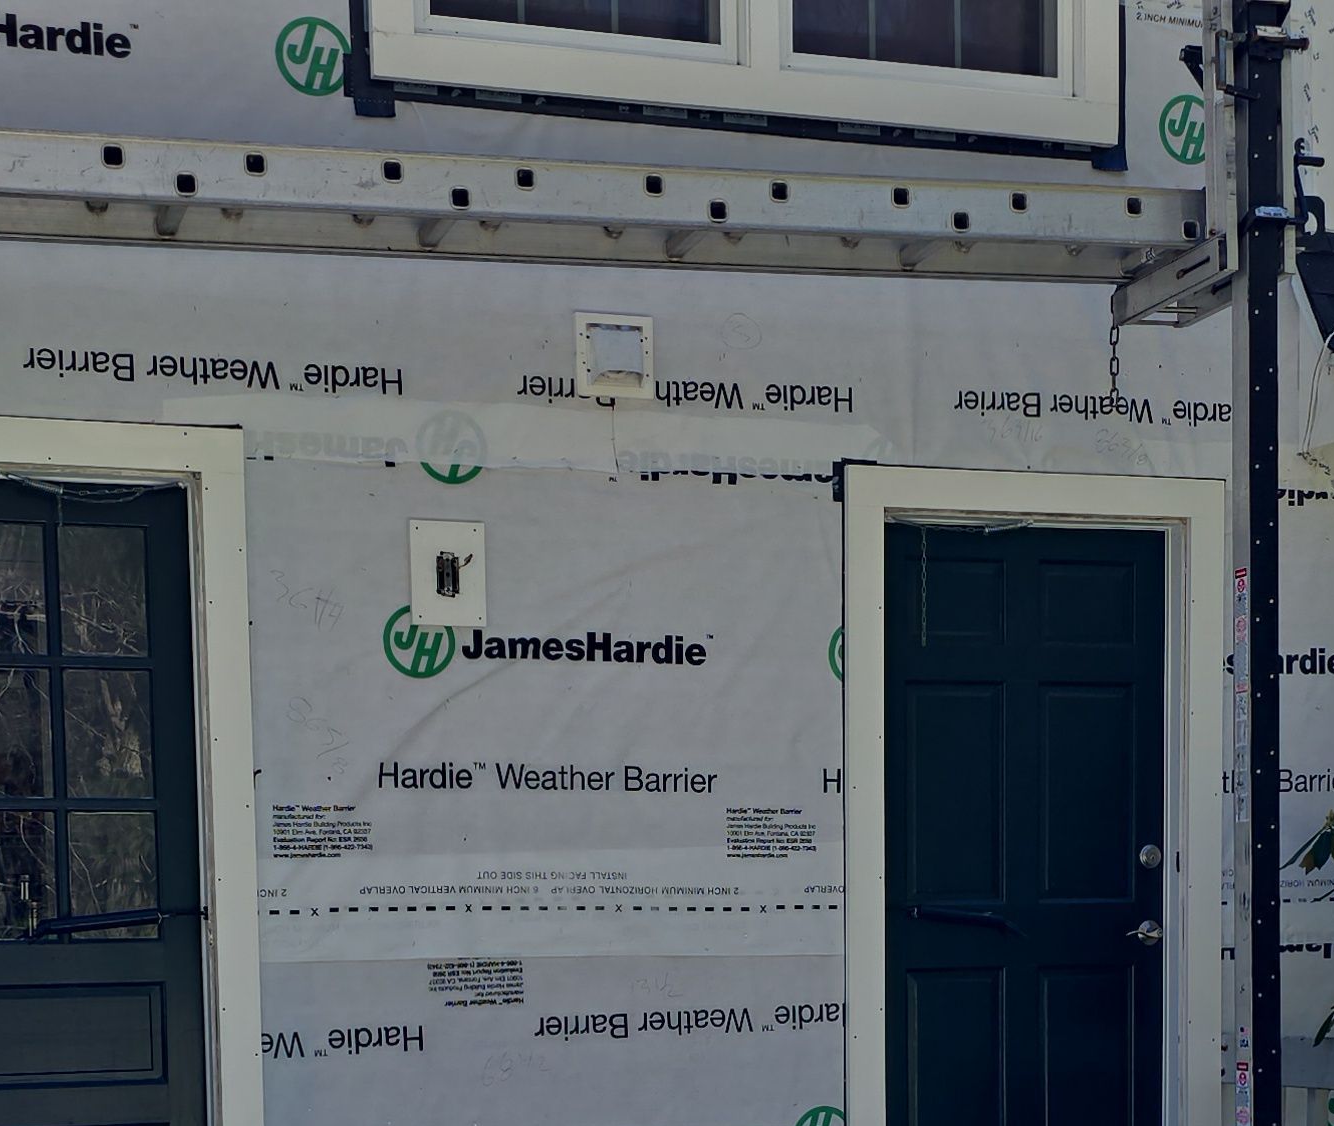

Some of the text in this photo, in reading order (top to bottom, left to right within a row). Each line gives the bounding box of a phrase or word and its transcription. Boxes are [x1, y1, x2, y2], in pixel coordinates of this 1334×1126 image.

[1143, 12, 1166, 25] INCH
[22, 347, 135, 382] Barrier
[148, 355, 280, 390] Weather
[953, 390, 1041, 418] Barrier
[1049, 391, 1154, 424] Weather
[495, 762, 616, 791] Weather
[624, 765, 718, 794] Barrier
[534, 1013, 629, 1042] Barrier
[637, 1007, 754, 1036] Weather
